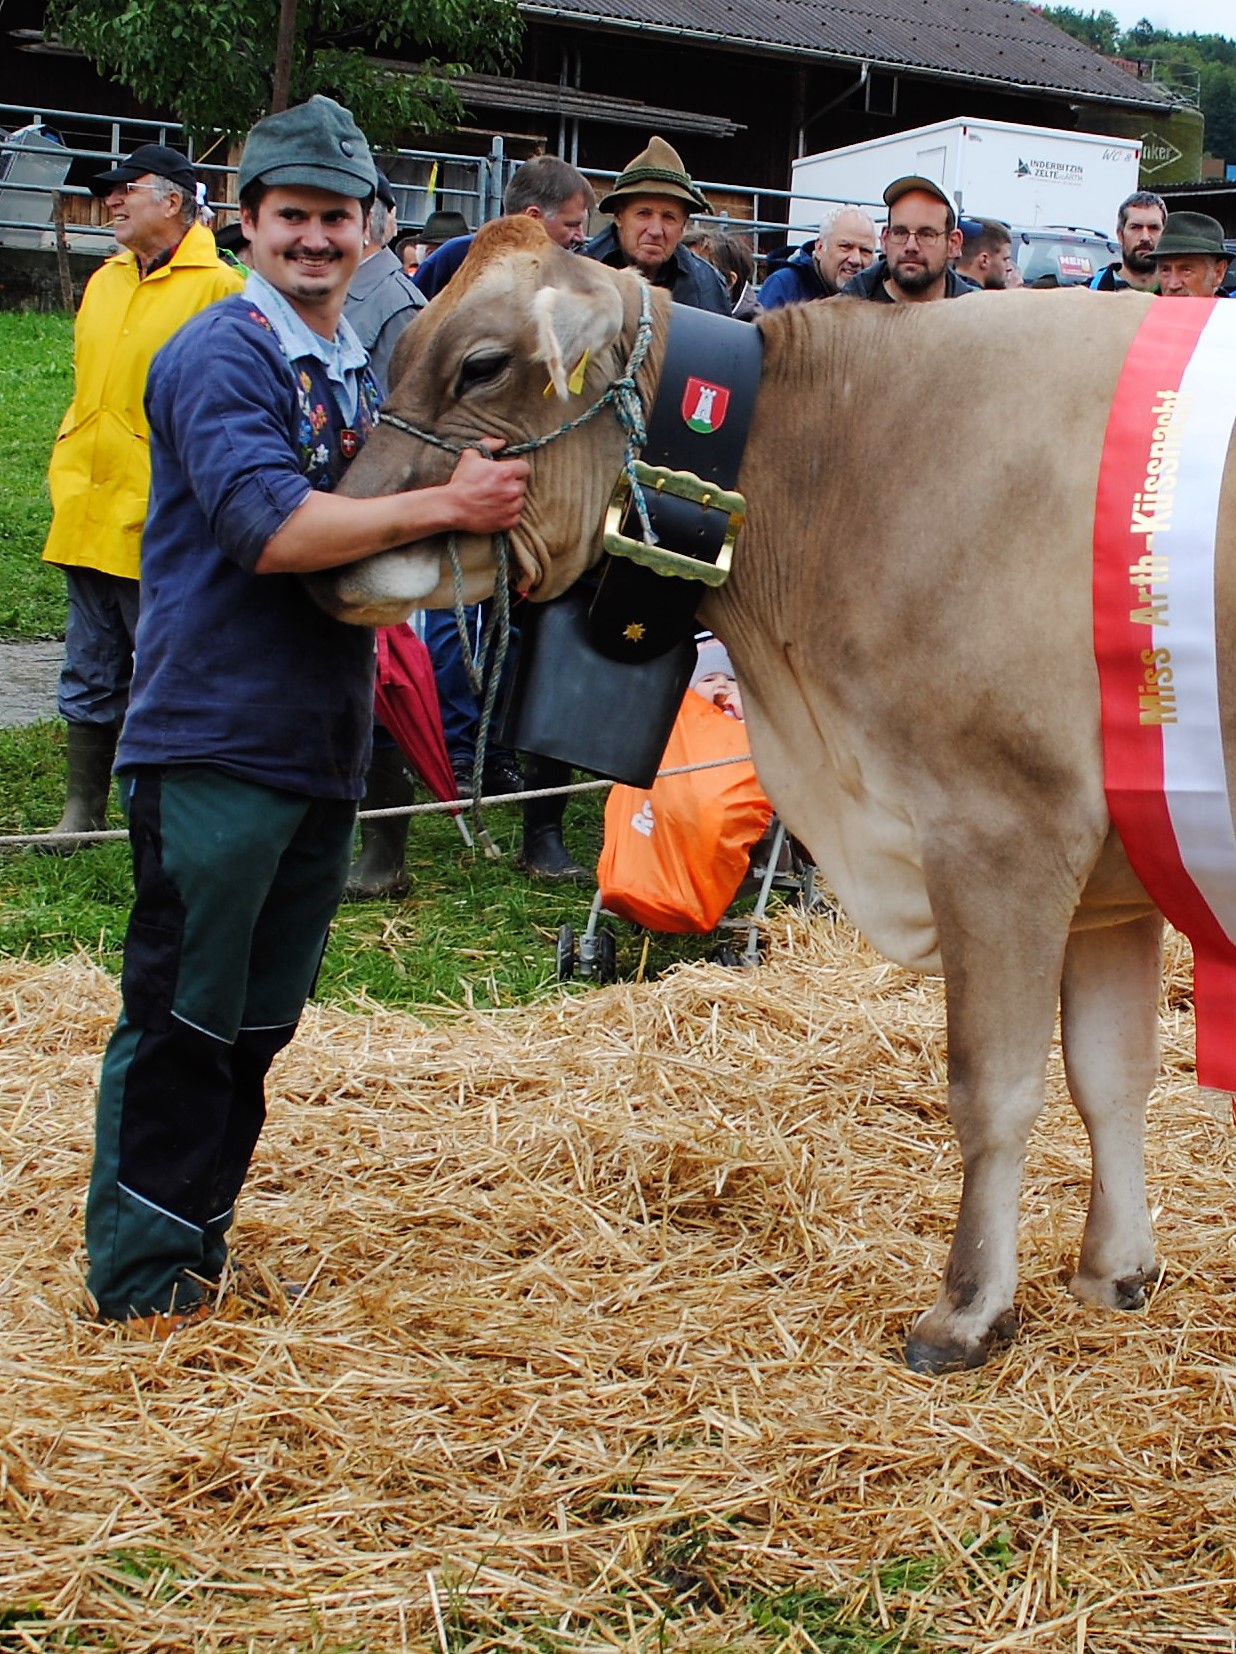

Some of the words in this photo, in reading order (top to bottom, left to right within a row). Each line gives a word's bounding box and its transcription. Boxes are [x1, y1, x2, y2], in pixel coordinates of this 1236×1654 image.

[1102, 149, 1122, 161] WC
[1030, 160, 1083, 173] INDERBITZIN
[1035, 169, 1057, 179] ZELTE
[1139, 648, 1178, 725] Miss
